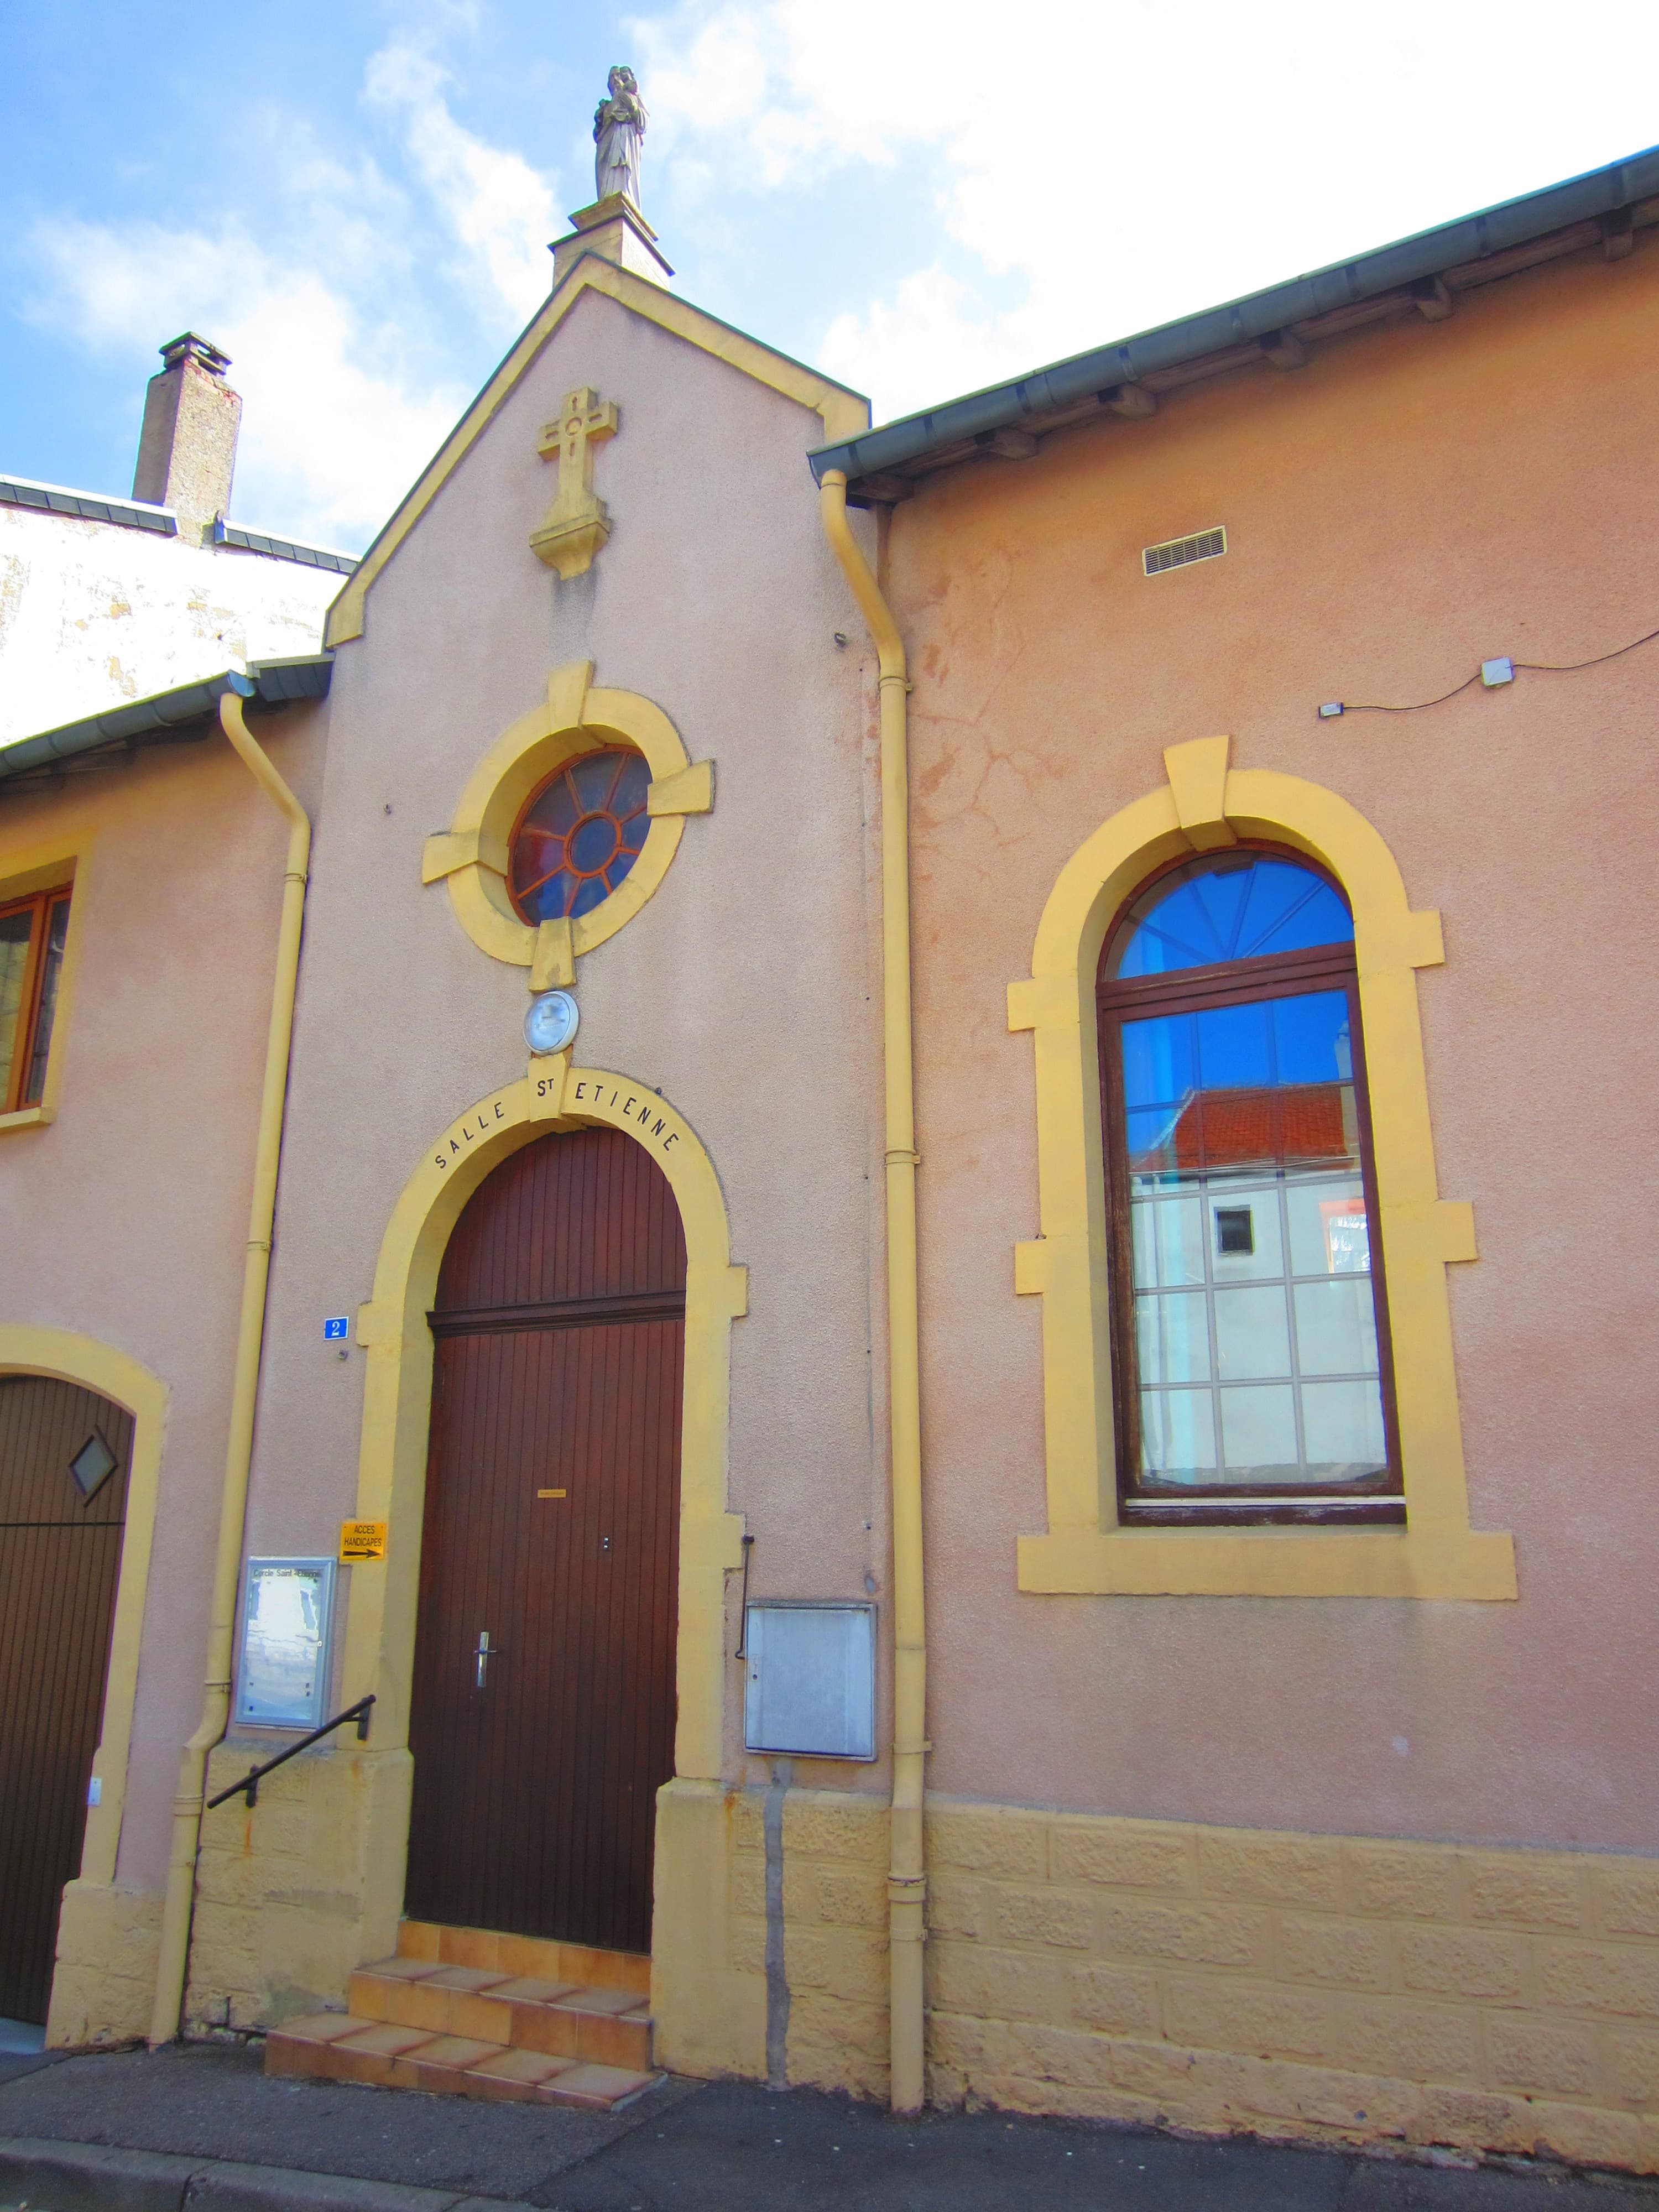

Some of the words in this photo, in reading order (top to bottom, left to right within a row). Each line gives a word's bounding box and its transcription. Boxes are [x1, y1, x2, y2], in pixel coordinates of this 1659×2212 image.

[435, 1102, 504, 1168] SALLE
[575, 1082, 679, 1151] ETIENNE
[332, 1321, 340, 1336] 2
[354, 1525, 375, 1534] ACCES
[345, 1537, 382, 1547] HANDICAPES
